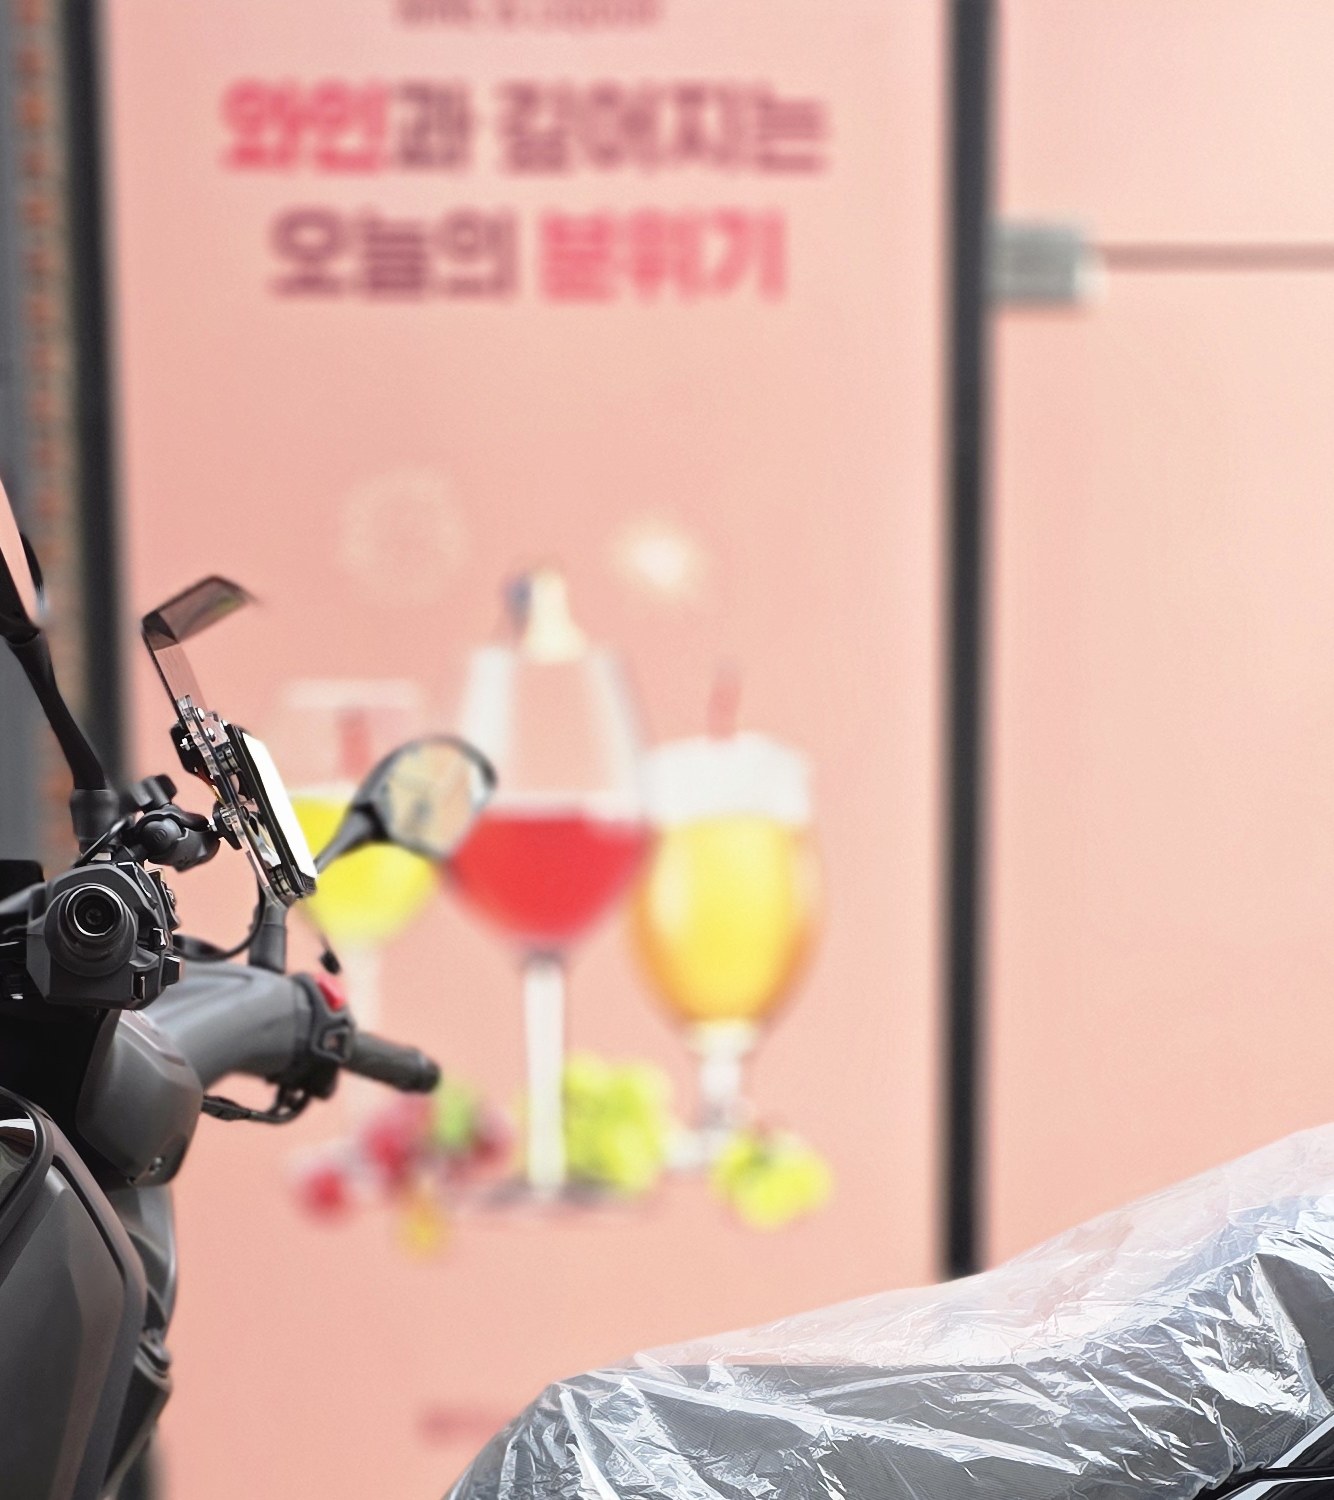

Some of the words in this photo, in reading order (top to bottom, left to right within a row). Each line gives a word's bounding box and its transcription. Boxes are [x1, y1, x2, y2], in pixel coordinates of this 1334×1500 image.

[223, 80, 475, 172] 와인과
[497, 80, 827, 174] 깊어지는
[270, 209, 517, 297] 오늘의
[539, 209, 787, 302] 분위기
